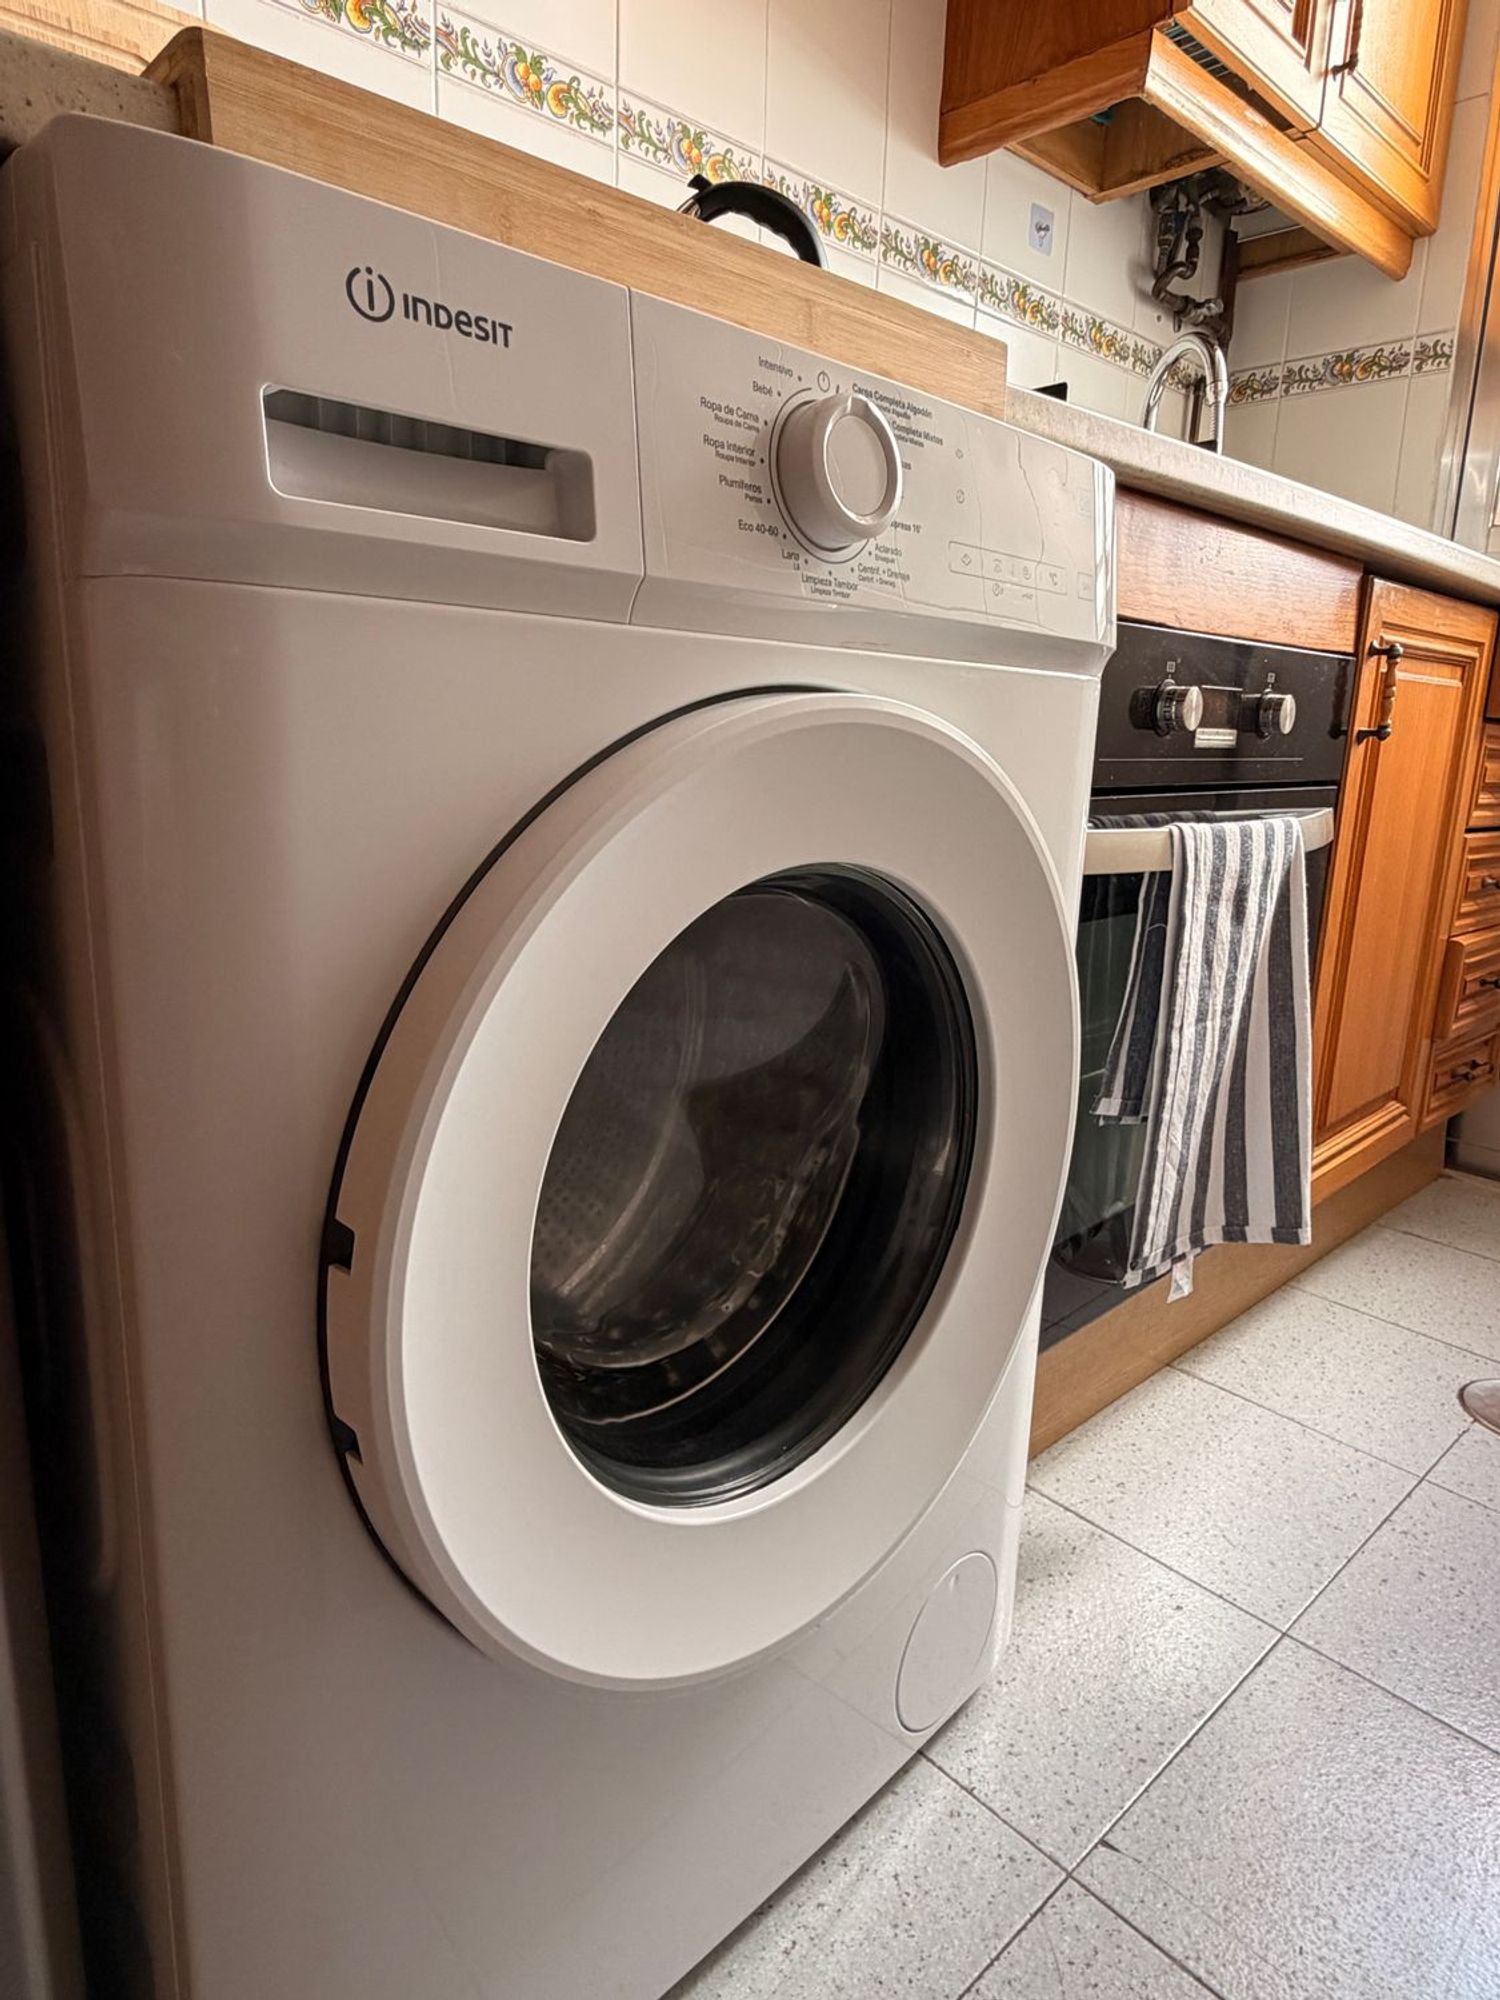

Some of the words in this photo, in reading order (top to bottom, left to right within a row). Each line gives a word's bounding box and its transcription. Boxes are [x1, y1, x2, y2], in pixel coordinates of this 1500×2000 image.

[758, 356, 793, 378] Intensivo
[752, 380, 773, 397] Bebé
[700, 396, 722, 413] Ropa
[724, 404, 734, 416] de
[736, 406, 759, 423] Cama
[874, 390, 906, 410] Completa
[906, 401, 932, 420] Algodón
[892, 420, 922, 438] Completa
[922, 431, 943, 446] Mixtos
[703, 434, 725, 450] Ropa
[726, 440, 755, 457] Interior
[738, 519, 753, 532] Eco
[755, 522, 779, 537] 40-60
[782, 549, 800, 561] Lana
[801, 571, 832, 587] Limpieza
[834, 577, 858, 591] Tambor
